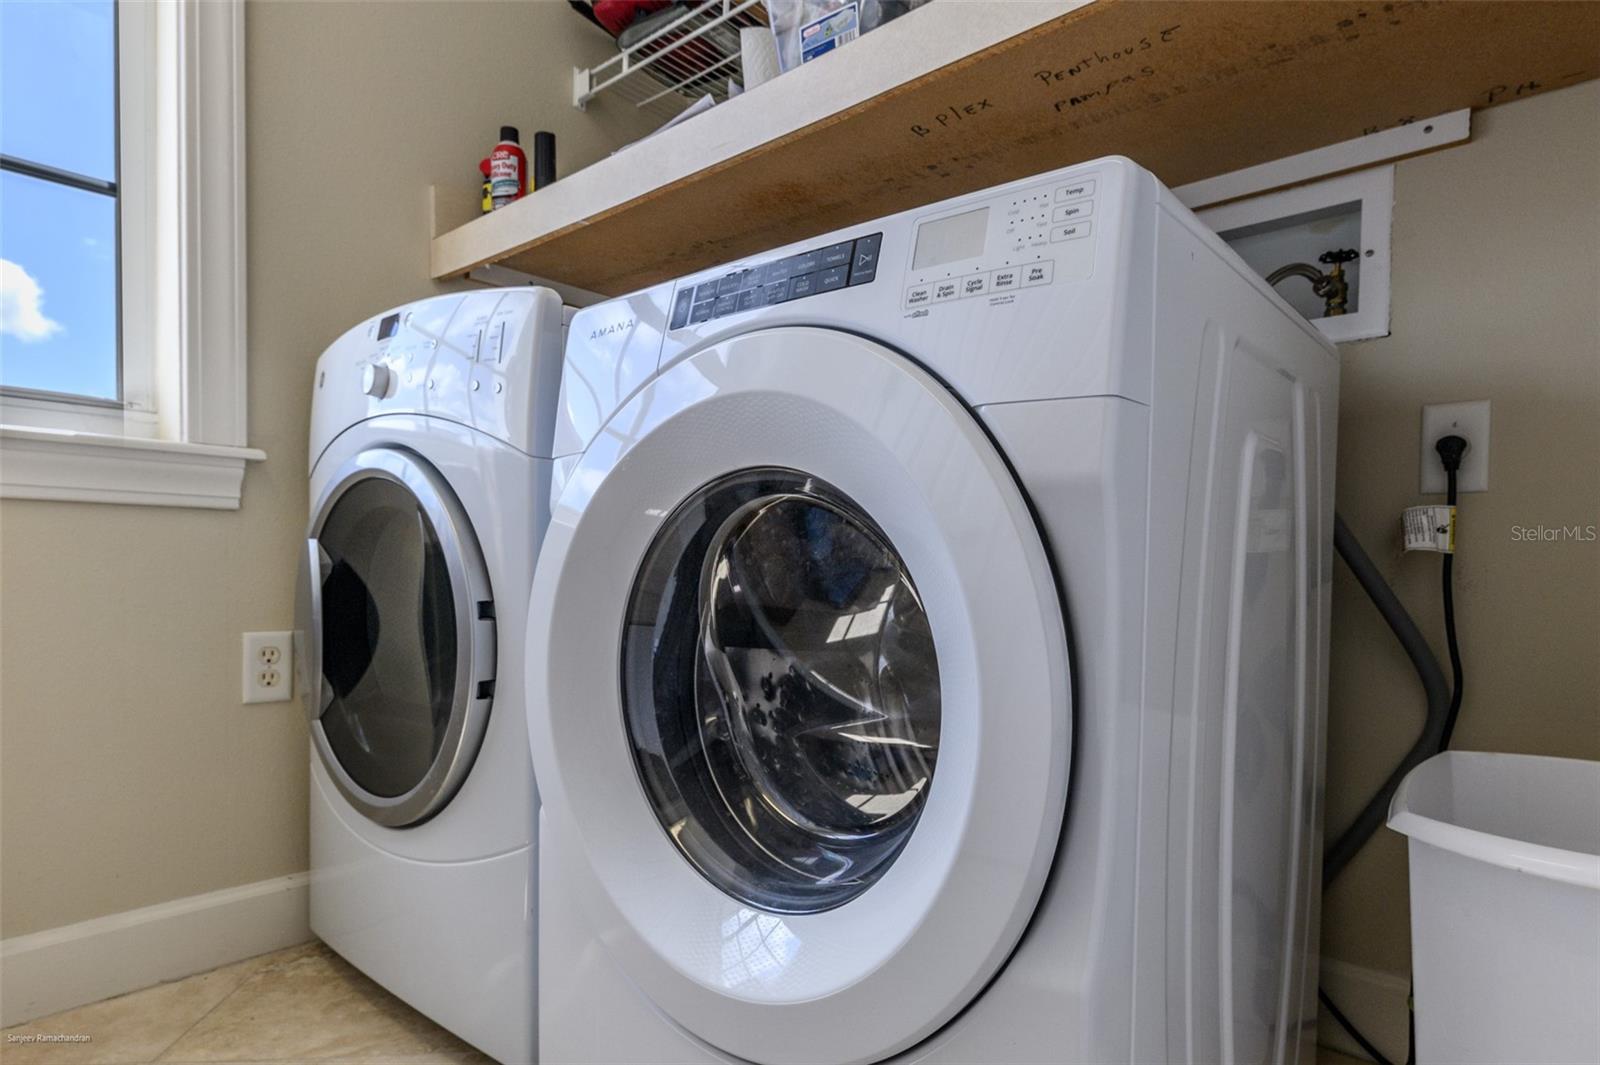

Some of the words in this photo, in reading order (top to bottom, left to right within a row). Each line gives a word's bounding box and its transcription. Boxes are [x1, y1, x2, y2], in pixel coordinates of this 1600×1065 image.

[1065, 187, 1084, 196] Temp
[1064, 208, 1080, 216] Spin
[1063, 227, 1076, 236] Soil
[997, 273, 1014, 281] Extra
[967, 279, 983, 287] Cycle
[995, 279, 1013, 287] Rinse
[965, 284, 983, 293] Signal
[911, 290, 928, 298] Clean
[941, 290, 955, 298] Spin
[908, 296, 929, 304] Washer
[590, 319, 634, 340] AMANA
